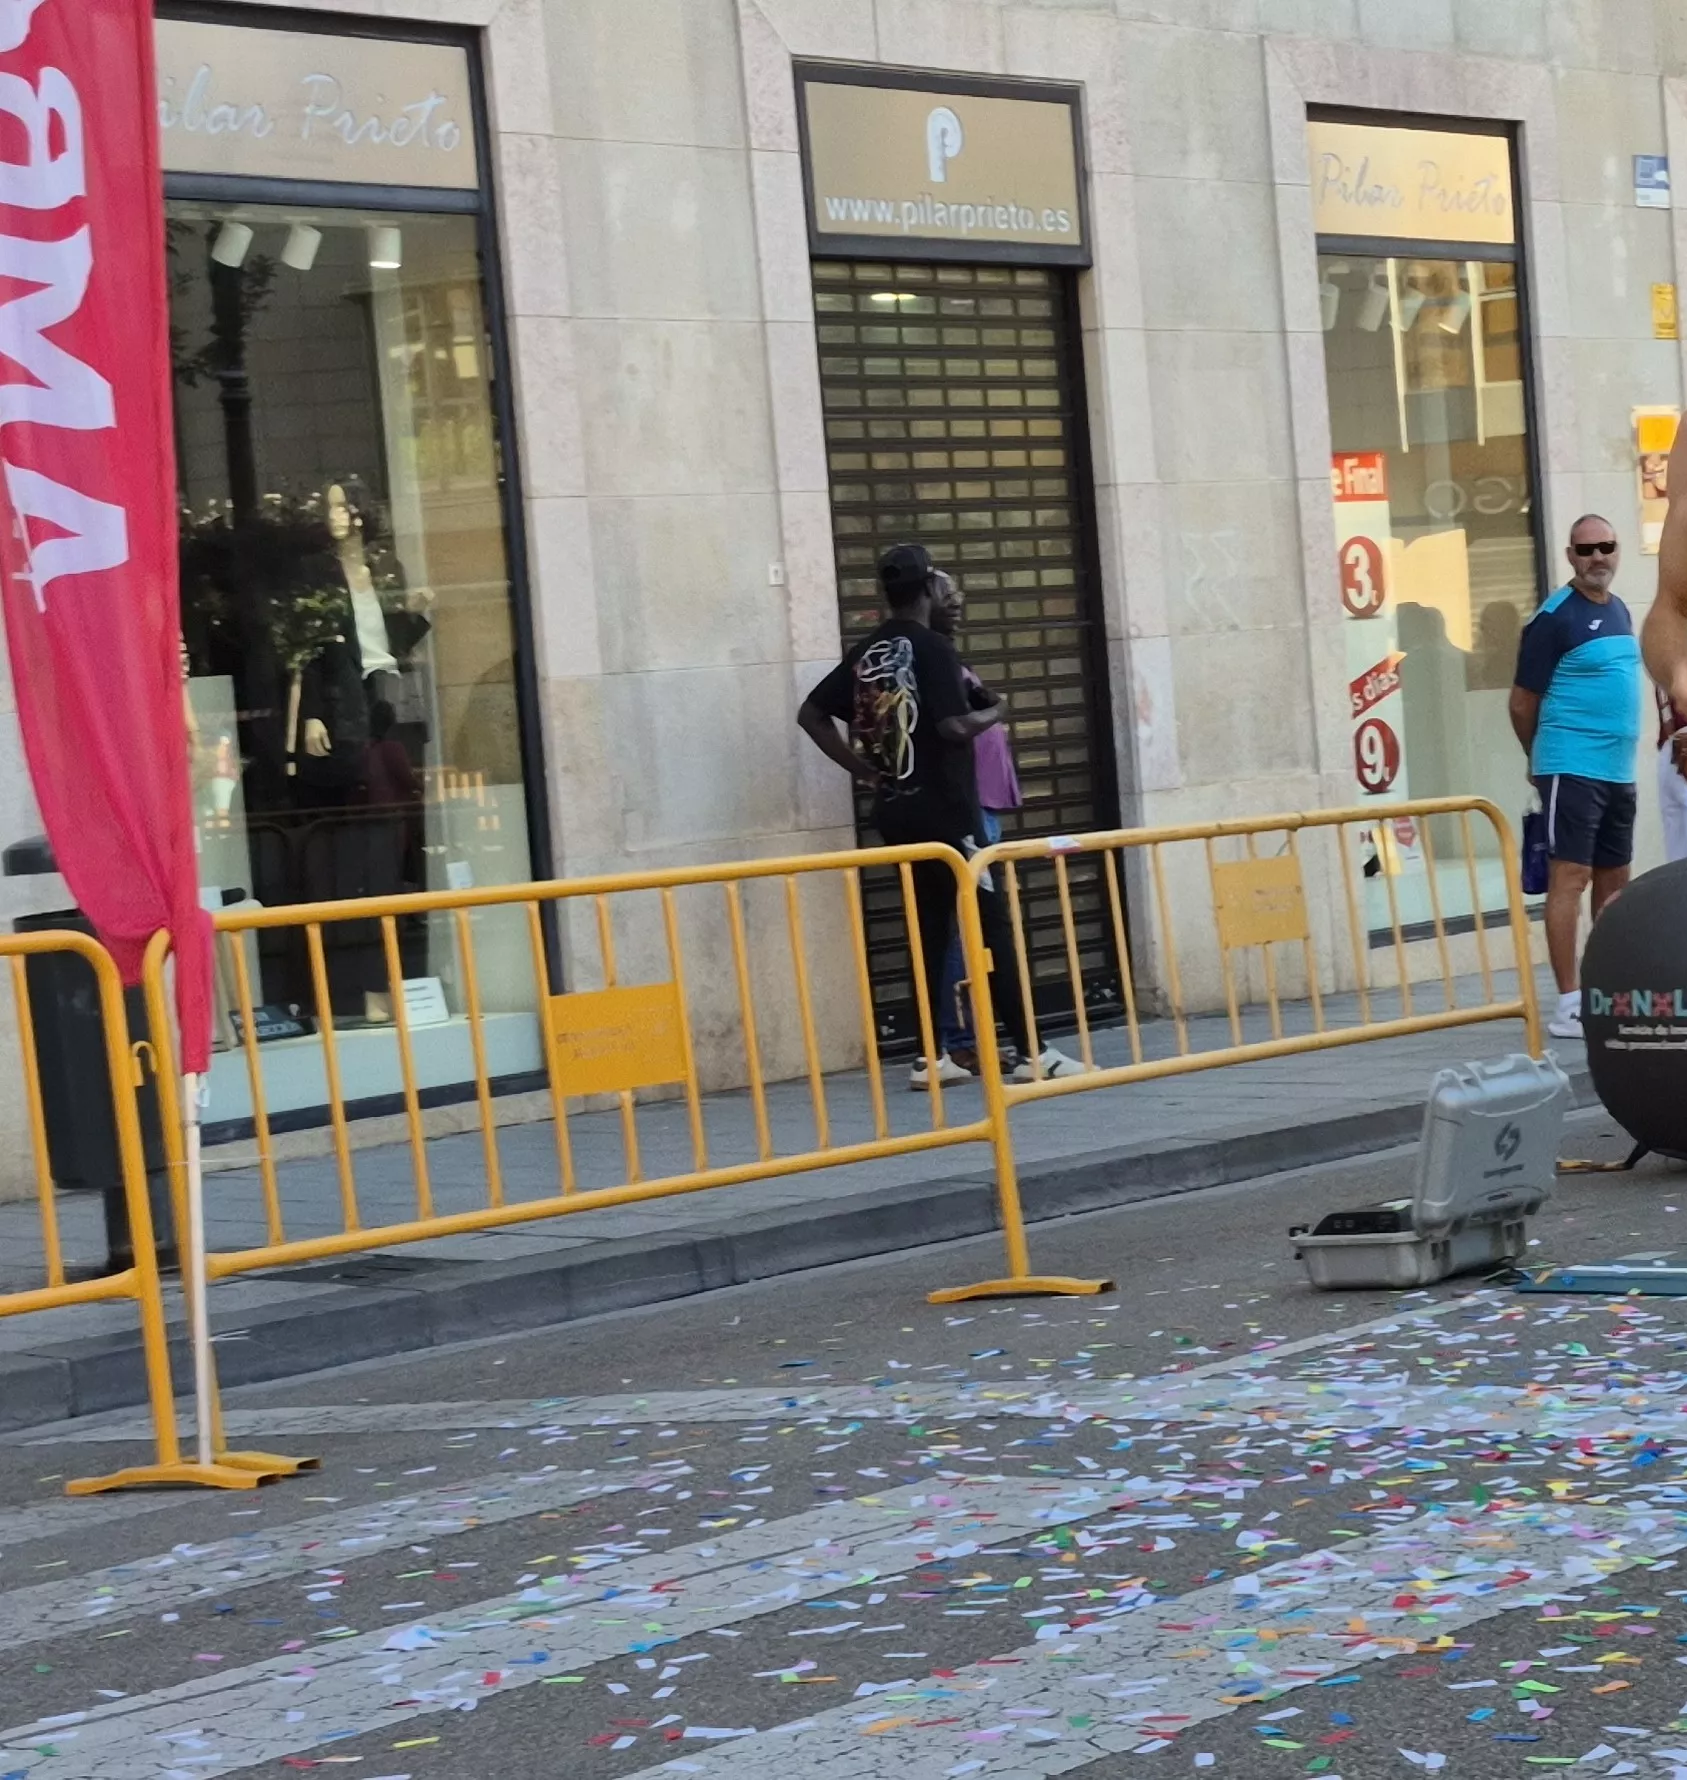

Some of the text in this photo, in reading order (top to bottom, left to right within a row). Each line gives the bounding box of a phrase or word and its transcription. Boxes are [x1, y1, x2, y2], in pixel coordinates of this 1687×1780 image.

[158, 63, 460, 151] ilar Prieto
[824, 193, 1071, 235] www.pilarprieto.es
[1318, 152, 1508, 216] Pilar Prieto
